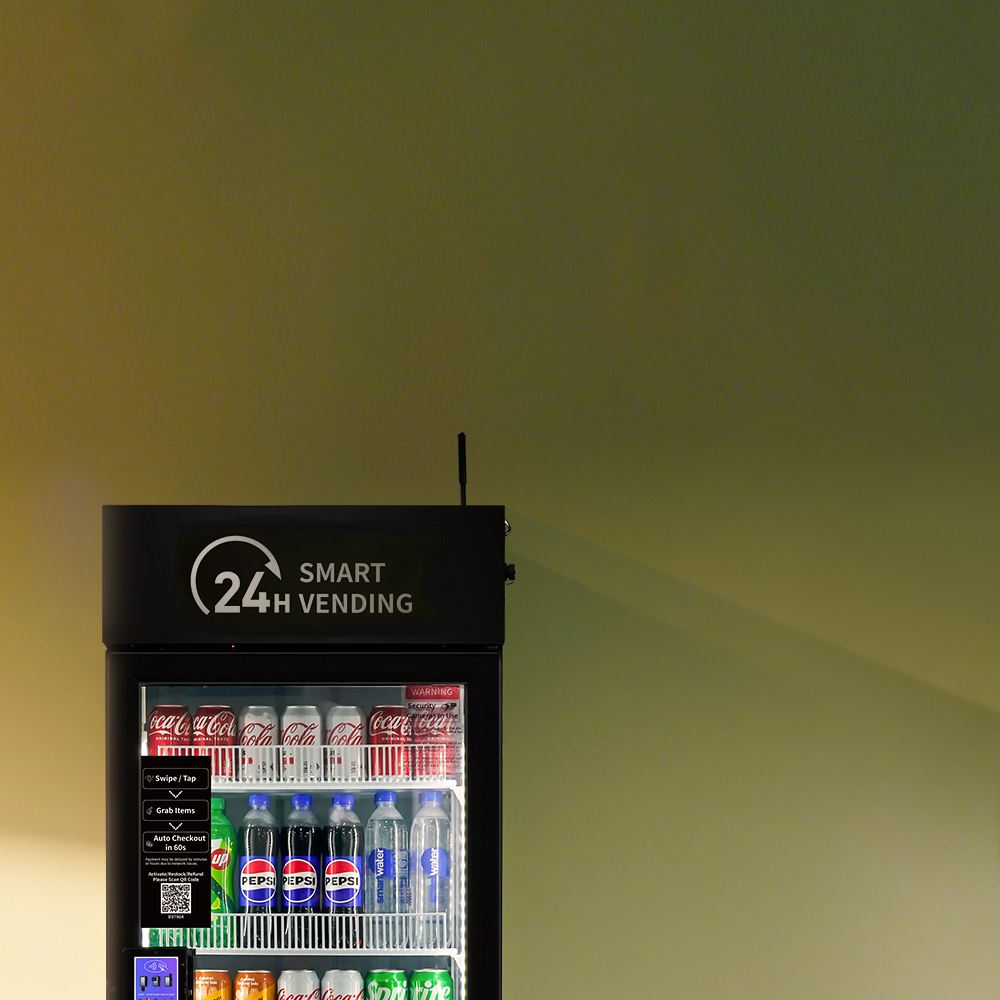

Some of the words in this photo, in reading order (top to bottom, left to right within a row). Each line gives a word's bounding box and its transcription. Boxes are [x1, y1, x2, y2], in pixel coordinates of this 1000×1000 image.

[299, 562, 386, 583] SMART
[299, 593, 413, 614] VENDING
[411, 688, 453, 696] WARNING
[407, 702, 437, 712] Security
[406, 712, 436, 720] Cameras
[446, 712, 459, 720] Use
[155, 774, 178, 783] Swipe
[183, 774, 197, 783] Tap
[156, 806, 174, 814] Grab
[153, 834, 171, 842] Auto
[171, 834, 206, 842] Checkout
[165, 843, 173, 851] in
[173, 843, 187, 851] 60s
[241, 876, 276, 886] PEPSI
[283, 876, 315, 886] PEPSI
[326, 876, 358, 886] PEPSI
